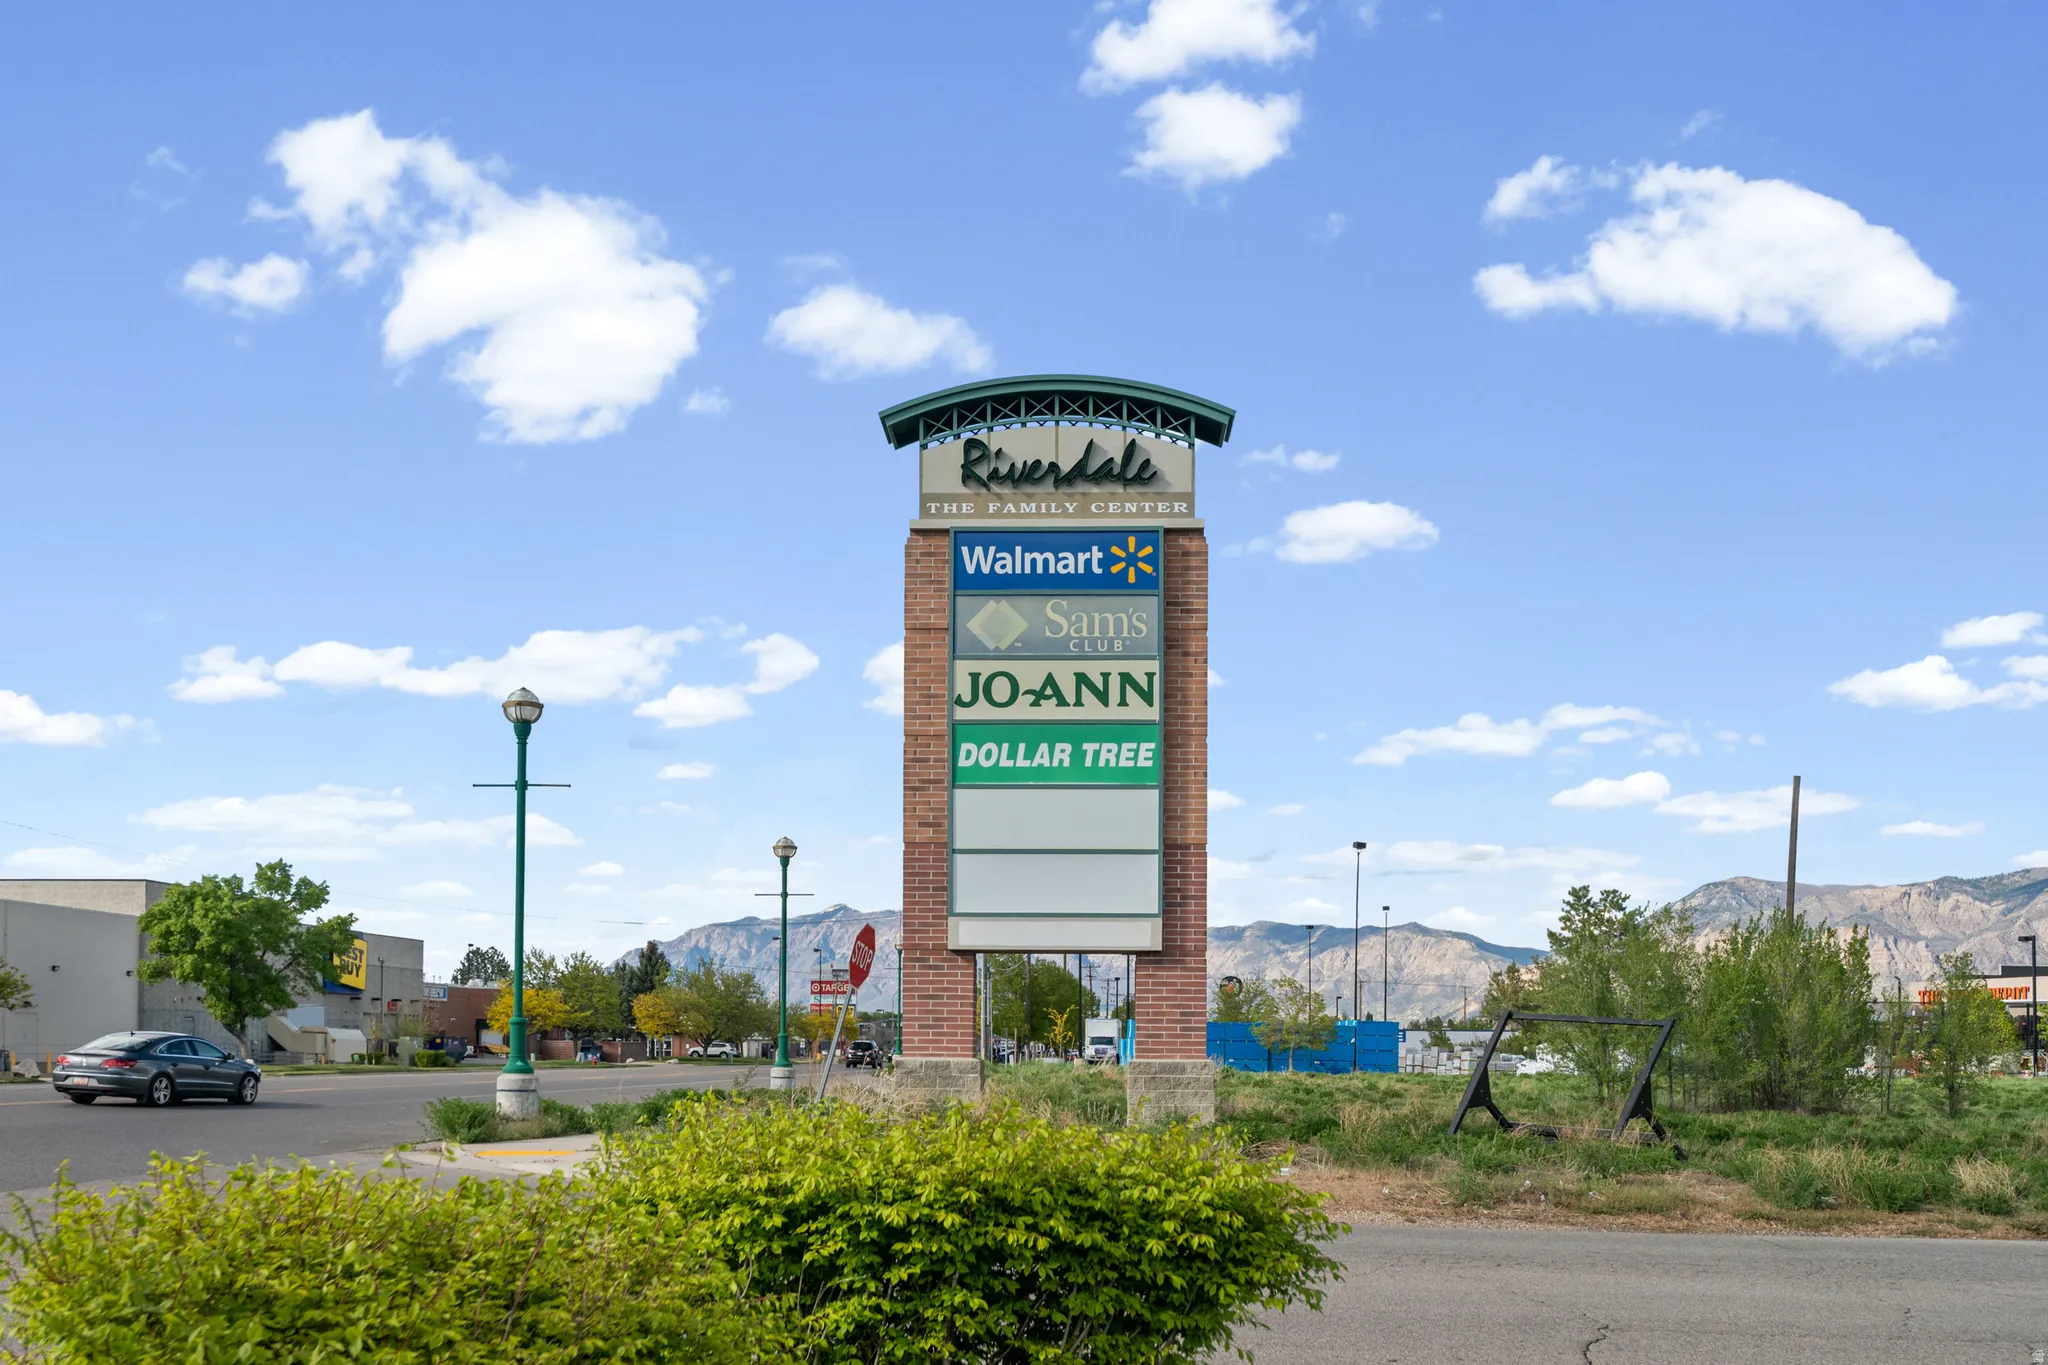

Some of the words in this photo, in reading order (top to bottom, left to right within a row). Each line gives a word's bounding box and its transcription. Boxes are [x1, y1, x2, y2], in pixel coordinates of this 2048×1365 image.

[960, 437, 1158, 491] Riverdale
[926, 502, 975, 514] THE
[988, 502, 1078, 514] FAMILY
[1090, 502, 1189, 514] CENTER
[961, 545, 1104, 574] Walmart
[1045, 599, 1148, 638] Sam's
[1069, 639, 1123, 652] CLUB
[958, 742, 1073, 768] DOLLAR
[1082, 742, 1156, 768] TREE
[851, 940, 874, 971] STOP
[821, 983, 849, 992] TARGE
